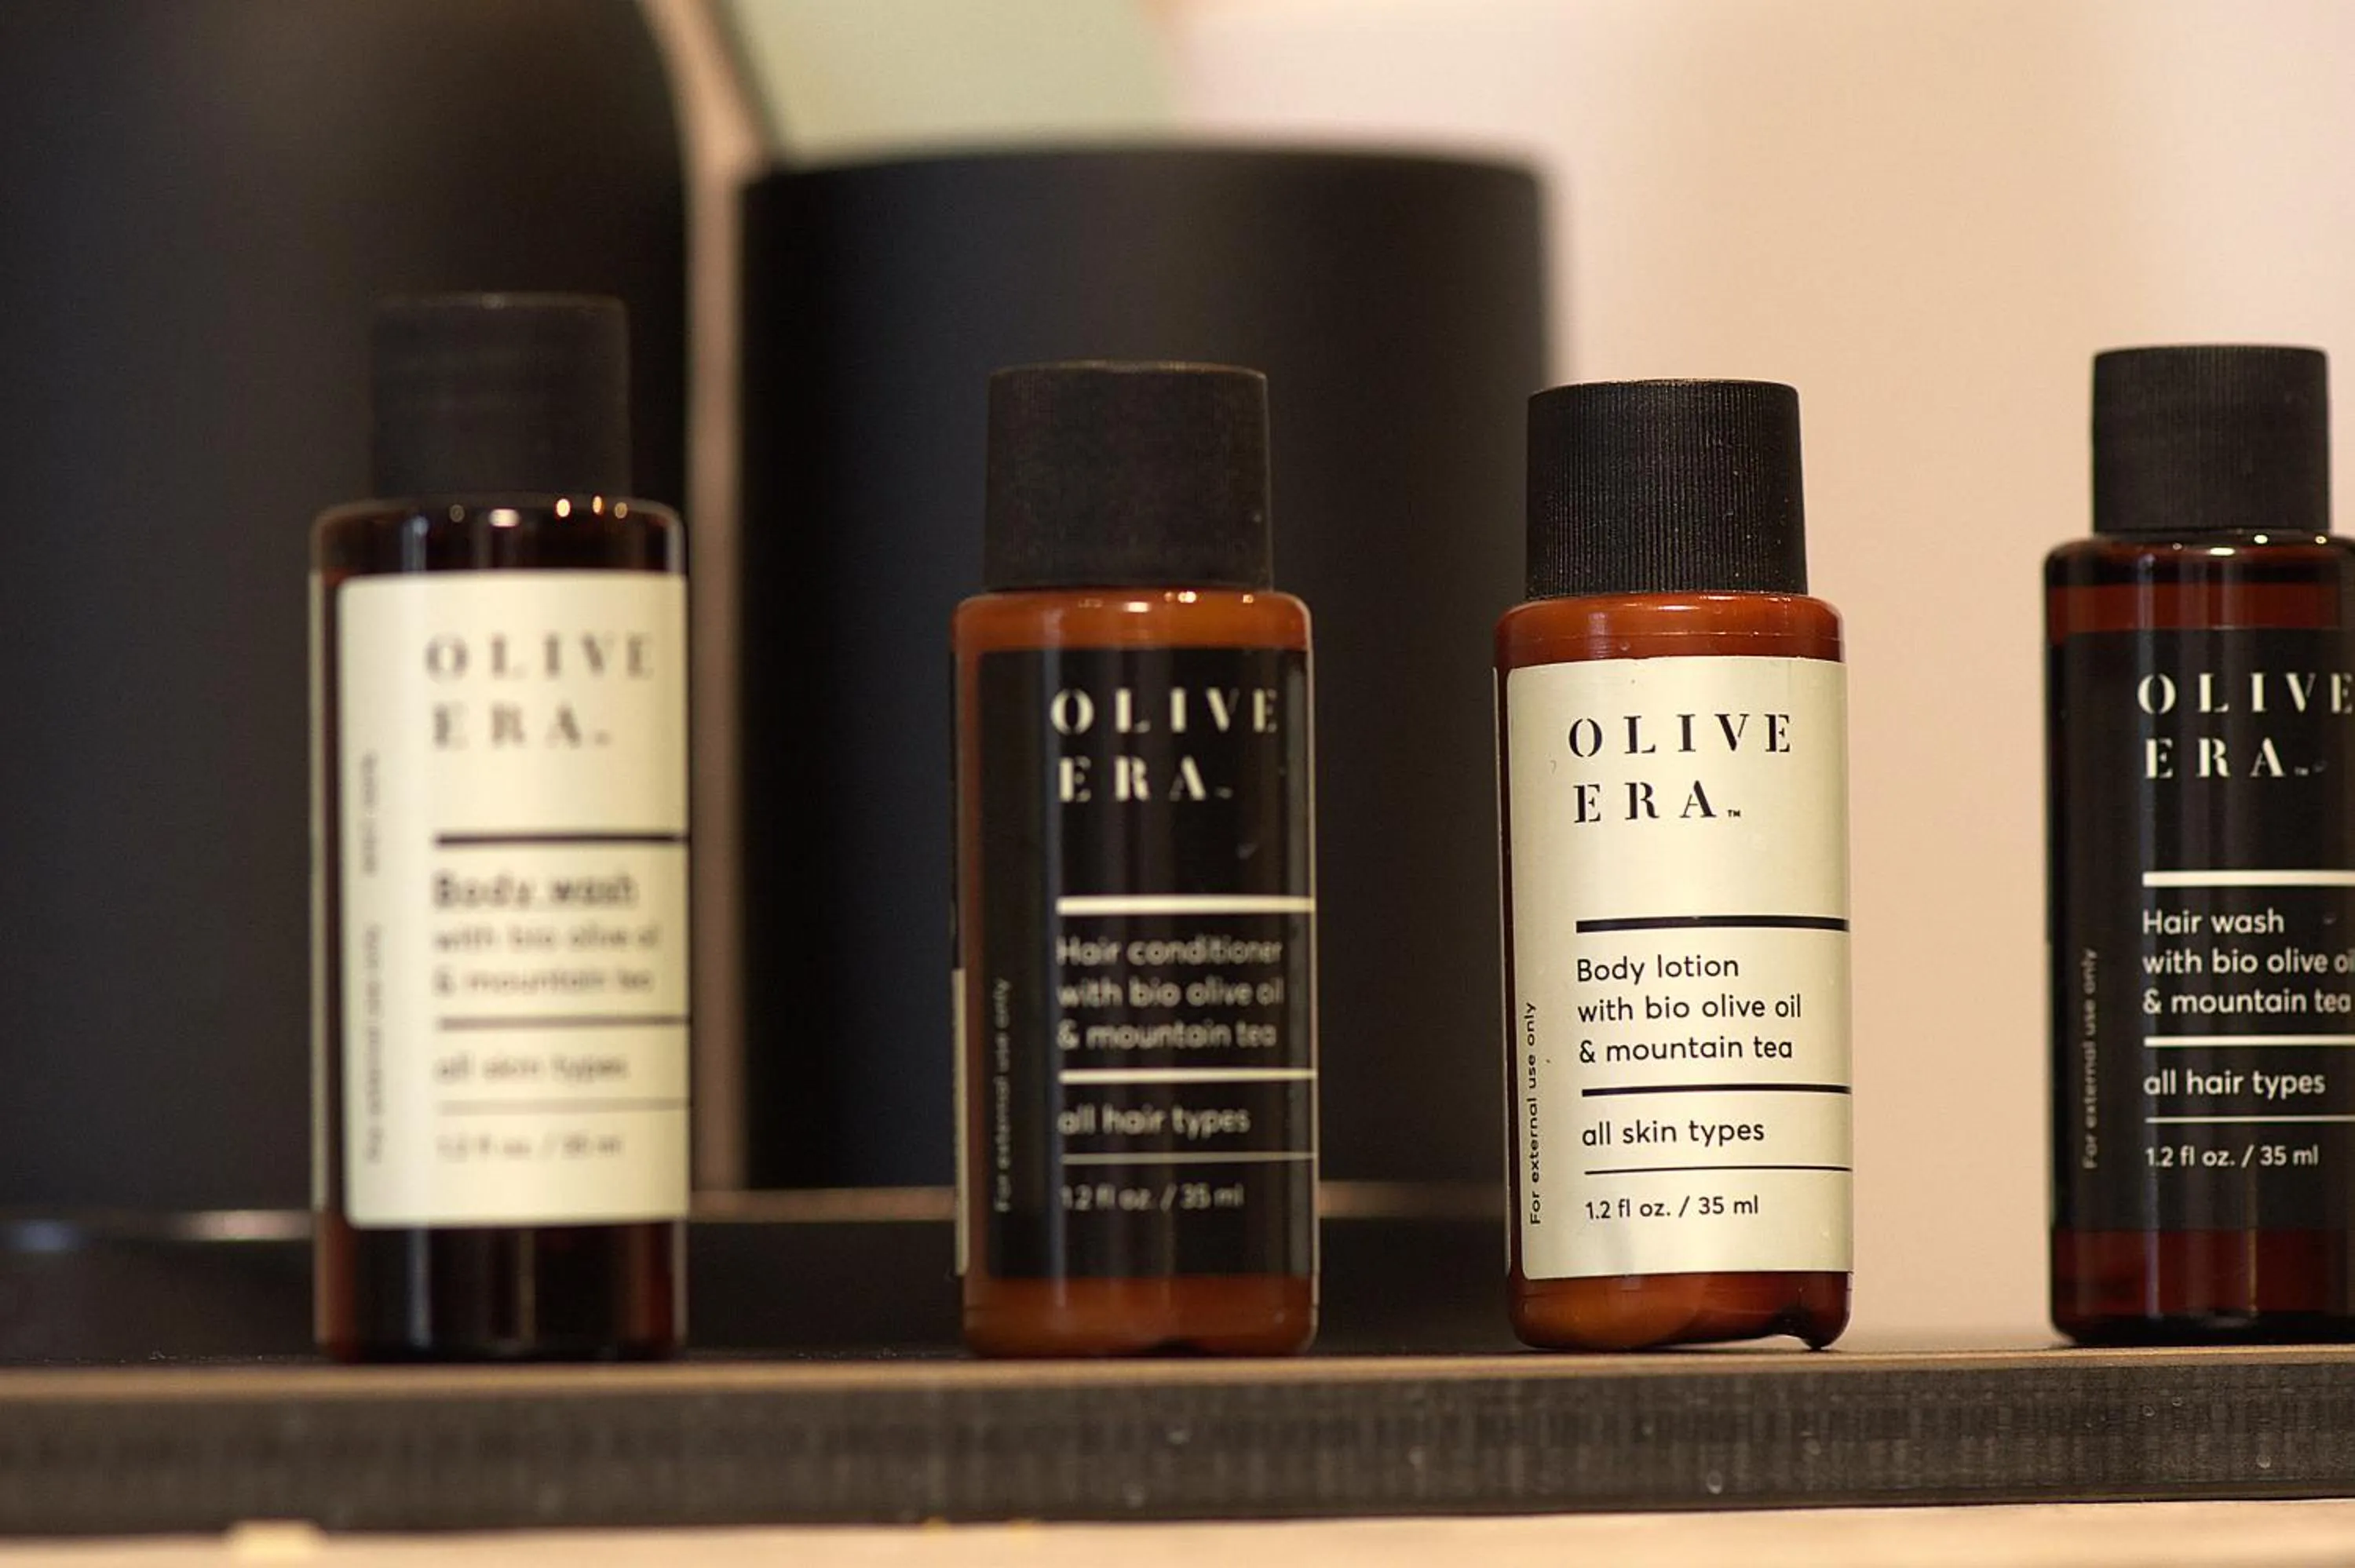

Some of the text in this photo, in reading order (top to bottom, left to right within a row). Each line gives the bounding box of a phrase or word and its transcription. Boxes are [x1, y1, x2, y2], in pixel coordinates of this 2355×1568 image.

[425, 630, 655, 681] OLIVE
[2137, 672, 2353, 715] OLIVE
[1050, 687, 1277, 735] OLIVE
[1569, 713, 1791, 757] OLIVE
[2142, 908, 2284, 935] Hair wash
[1057, 934, 1282, 965] Hair conditioner
[2143, 946, 2355, 974] with bio olive oi
[1577, 954, 1739, 985] Body lotion
[2080, 948, 2098, 994] only
[1057, 978, 1123, 1008] with
[1128, 976, 1181, 1007] bio
[1186, 975, 1254, 1007] olive
[2142, 987, 2351, 1014] & mountain tea
[1578, 994, 1801, 1022] with bio olive oil
[1057, 1019, 1277, 1049] & mountain tea
[1579, 1036, 1793, 1063] & mountain tea
[2081, 1041, 2097, 1129] external
[2143, 1068, 2325, 1099] all hair types
[1058, 1103, 1251, 1140] all hair types
[1524, 1002, 1541, 1225] For external use only
[1582, 1120, 1765, 1147] all skin types
[2083, 1136, 2098, 1169] For
[2180, 1145, 2195, 1167] fl
[2202, 1150, 2236, 1167] oz.
[2241, 1143, 2255, 1169] /
[2259, 1145, 2287, 1166] 35
[2292, 1144, 2319, 1166] ml
[1586, 1195, 1758, 1219] 1.2 fl oz. / 35 ml
